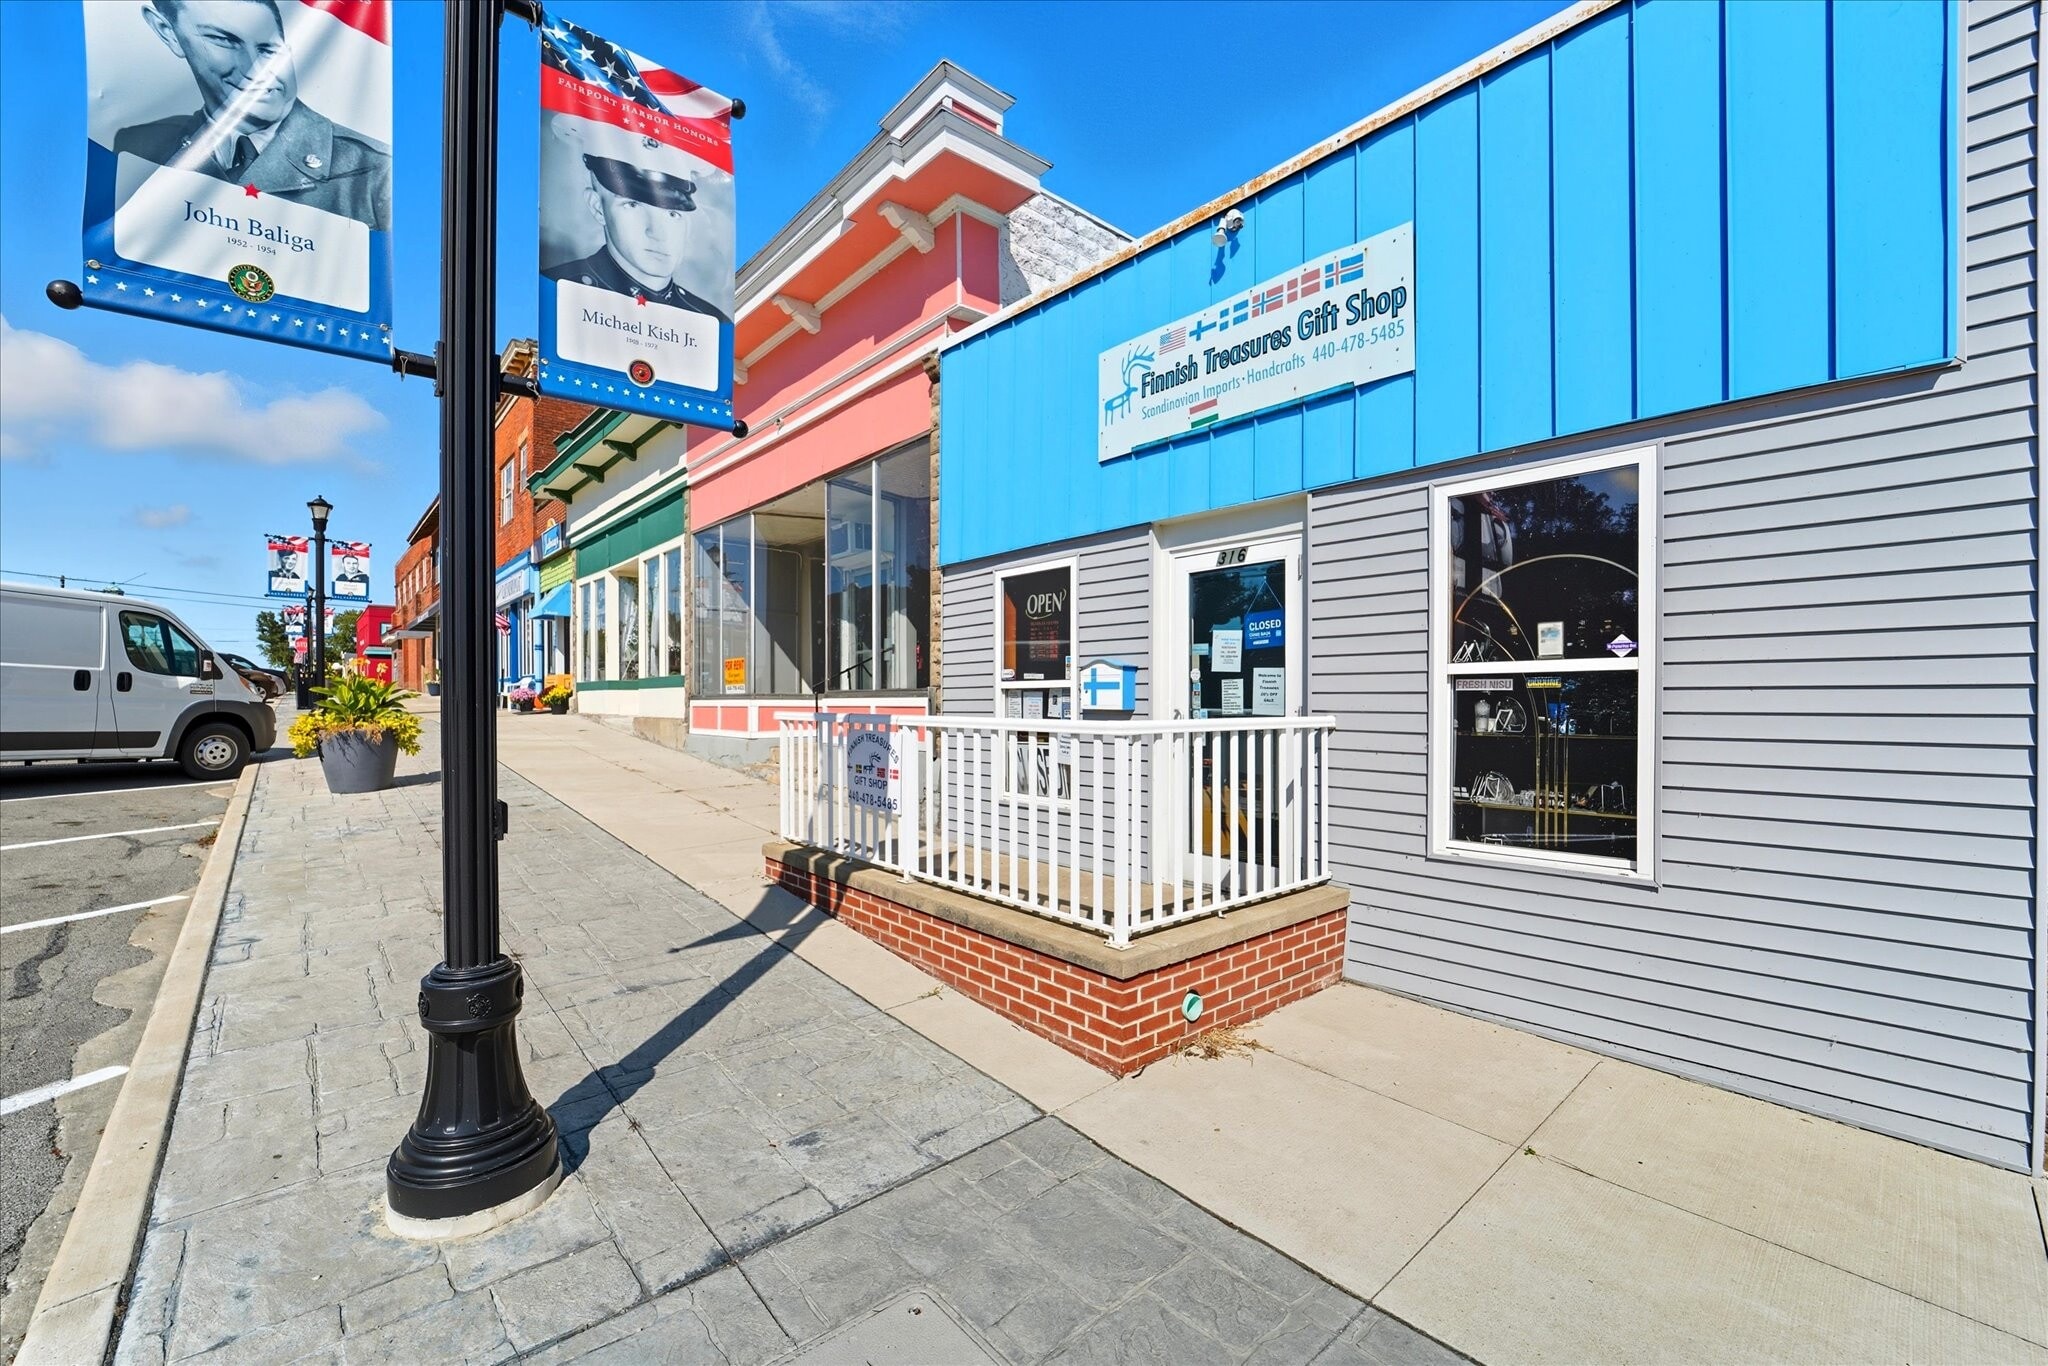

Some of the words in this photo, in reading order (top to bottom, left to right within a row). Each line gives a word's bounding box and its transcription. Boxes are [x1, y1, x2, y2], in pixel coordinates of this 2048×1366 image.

[557, 76, 618, 107] FAIRPORT
[621, 104, 670, 127] HARBOR
[673, 122, 719, 147] HONORS
[184, 200, 240, 231] John
[247, 218, 315, 252] Baliga
[227, 236, 248, 248] 1952
[257, 244, 277, 255] 1954
[582, 308, 642, 335] Michael
[647, 324, 679, 343] Kish
[683, 332, 698, 348] Jr.
[1141, 354, 1198, 399] Finnish
[1203, 325, 1292, 375] Treasures
[1297, 300, 1340, 341] Gift
[1345, 285, 1407, 326] Shop
[1203, 376, 1241, 400] Imports
[1247, 353, 1305, 385] Handcrafts
[1312, 319, 1405, 362] 440-478-5485
[1218, 548, 1247, 565] 316
[1026, 590, 1065, 616] OPEN
[1249, 619, 1282, 631] CLOSED
[1456, 680, 1488, 690] FRESH
[1489, 679, 1512, 689] NISU
[865, 733, 900, 764] TREASURES
[854, 775, 867, 786] GIFT
[868, 778, 888, 790] SHOP
